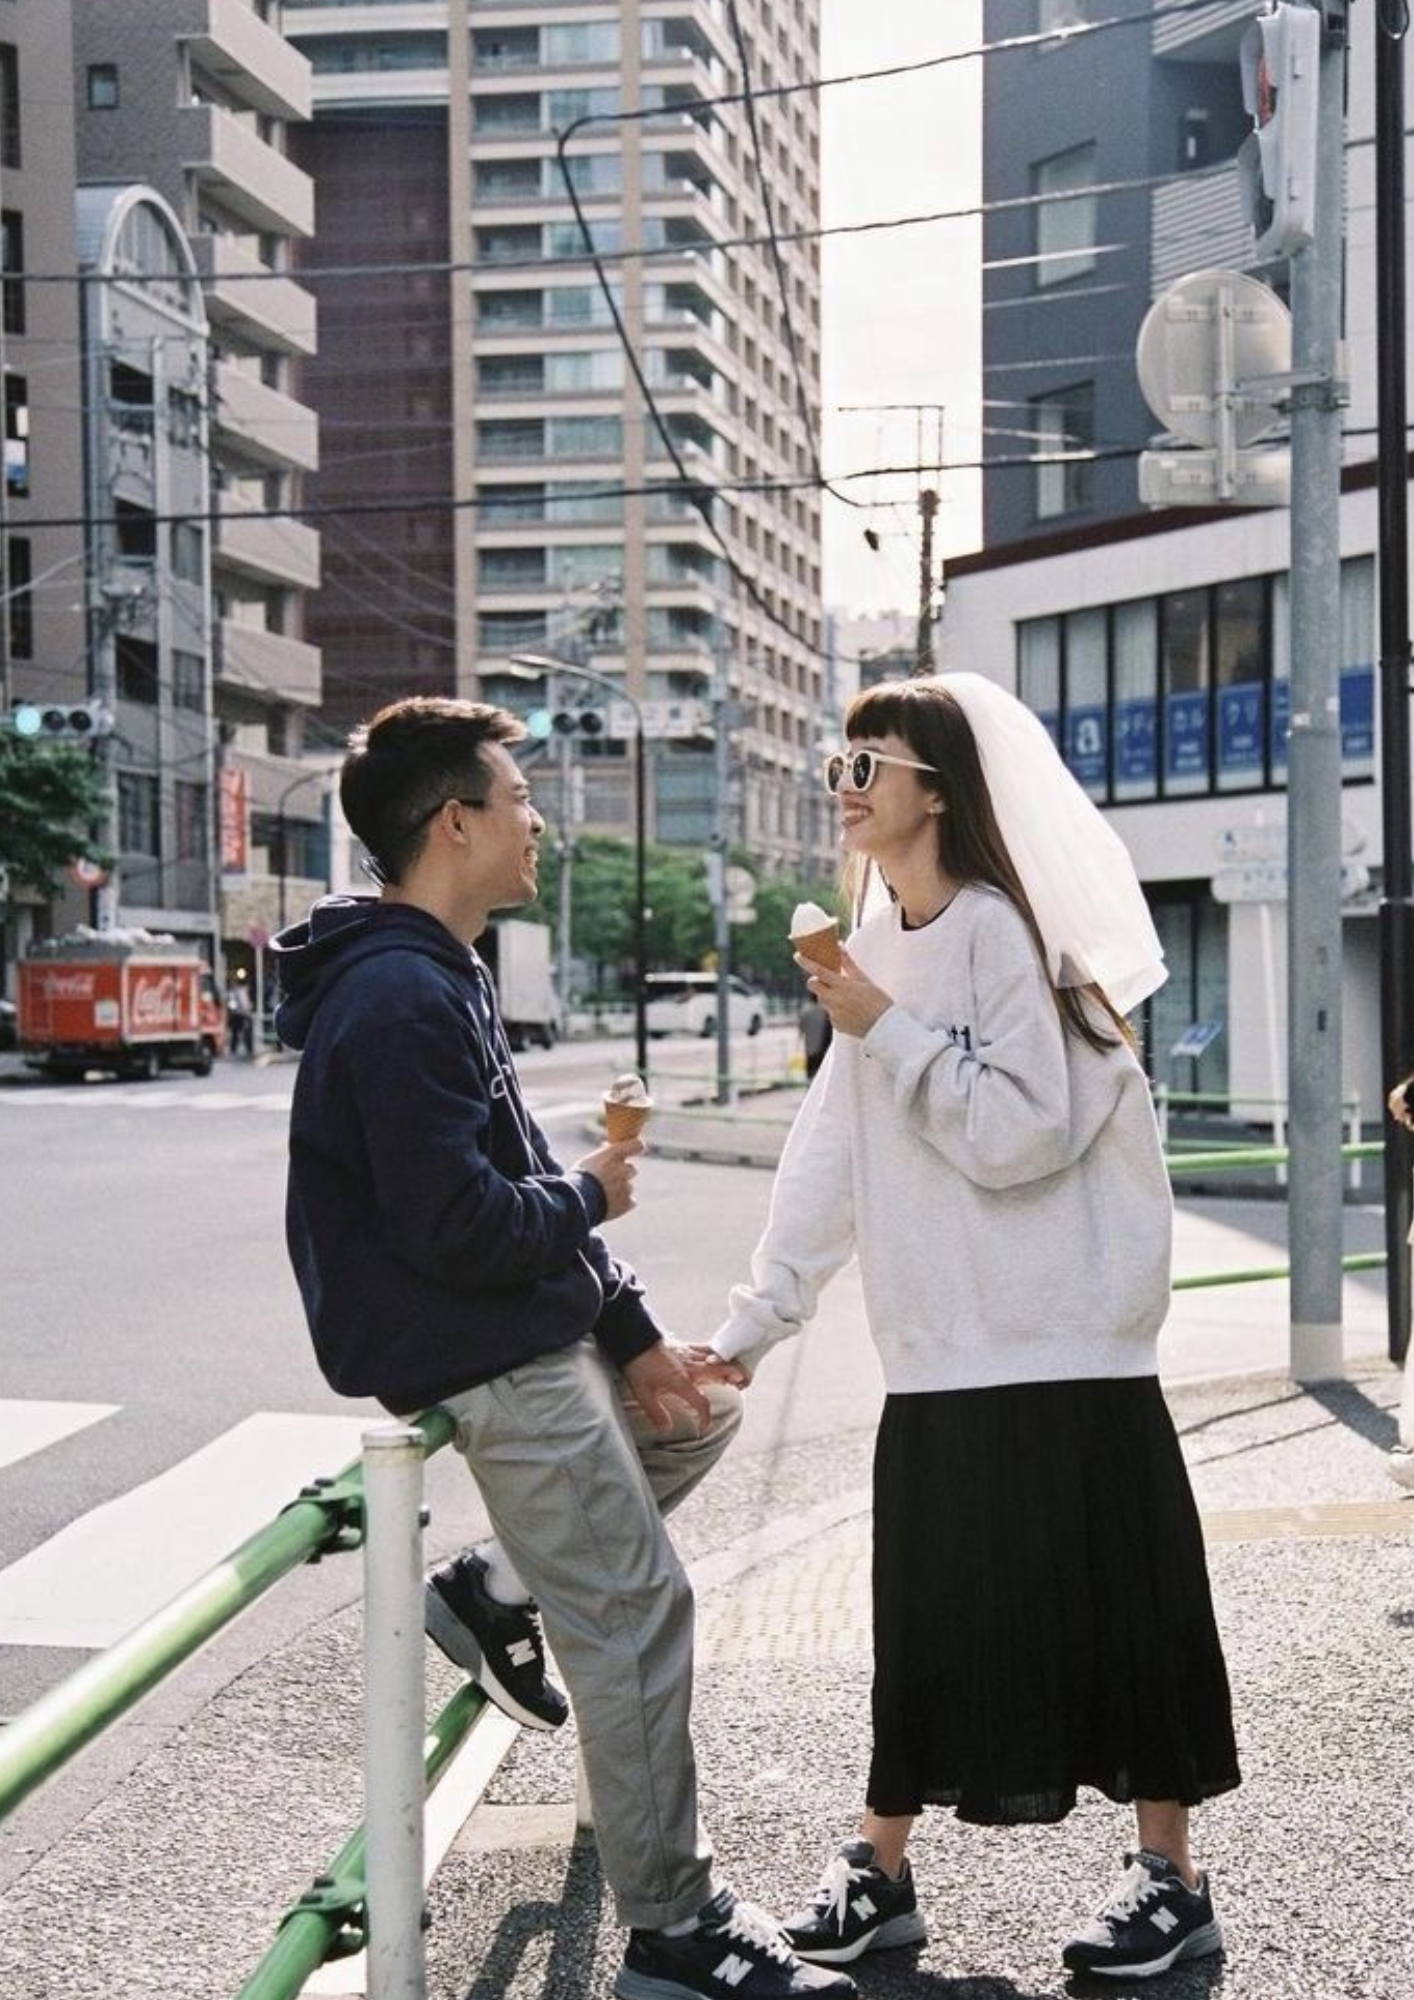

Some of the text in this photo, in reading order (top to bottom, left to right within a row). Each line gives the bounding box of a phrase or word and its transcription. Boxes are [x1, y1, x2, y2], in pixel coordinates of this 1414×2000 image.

[1076, 717, 1101, 755] a
[505, 1638, 537, 1667] N
[851, 1893, 878, 1921] N
[1149, 1906, 1179, 1934] N
[711, 1953, 755, 1987] N
